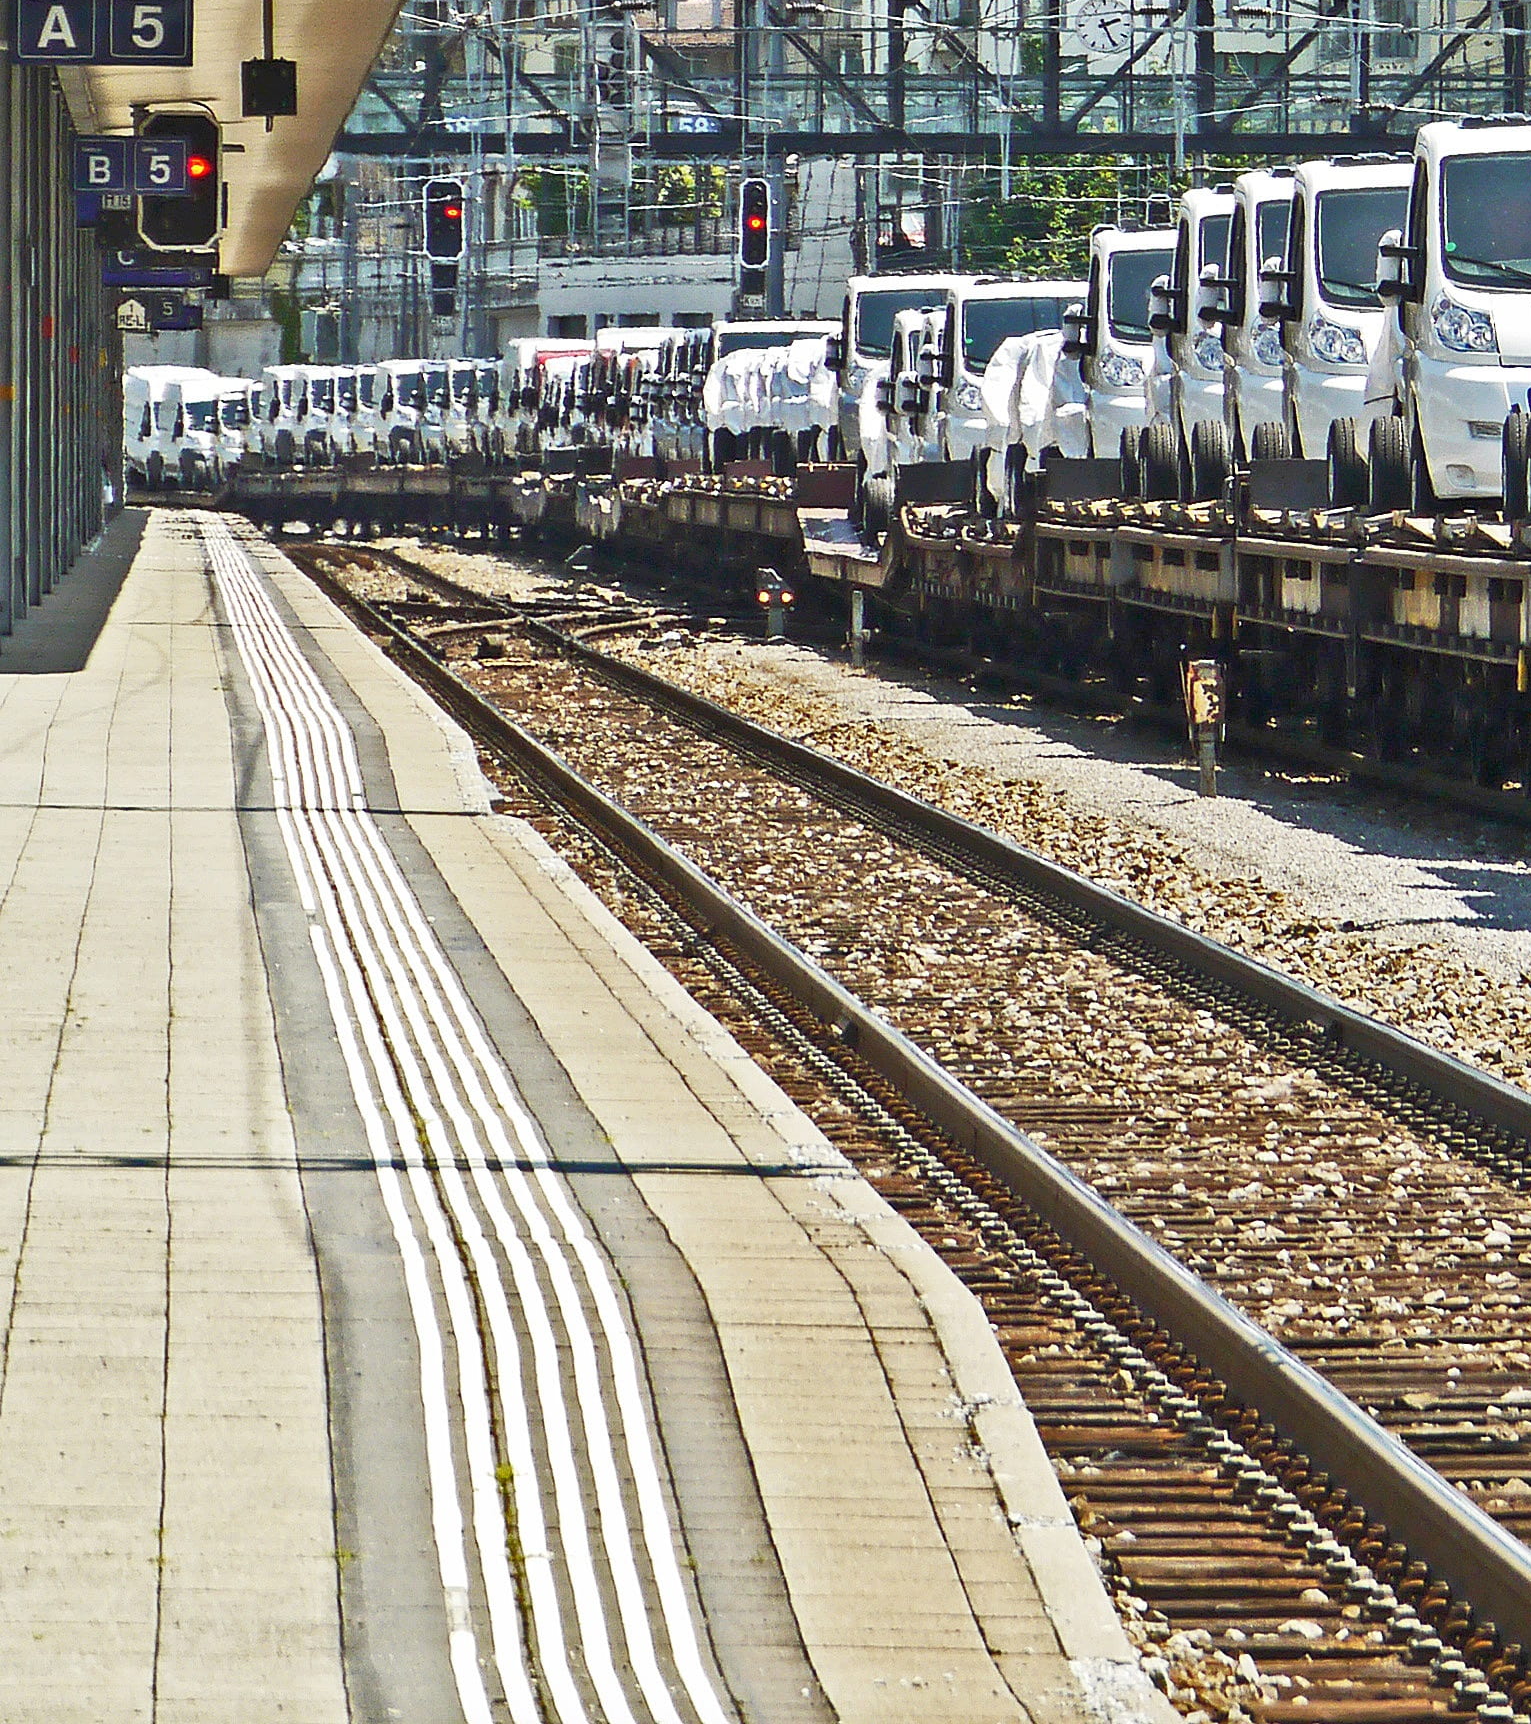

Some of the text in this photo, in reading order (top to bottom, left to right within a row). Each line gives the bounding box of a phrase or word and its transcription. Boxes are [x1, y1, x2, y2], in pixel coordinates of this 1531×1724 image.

[37, 5, 77, 49] A
[131, 5, 164, 49] 5
[88, 155, 111, 184] B
[150, 155, 171, 184] 5
[163, 302, 174, 316] 5
